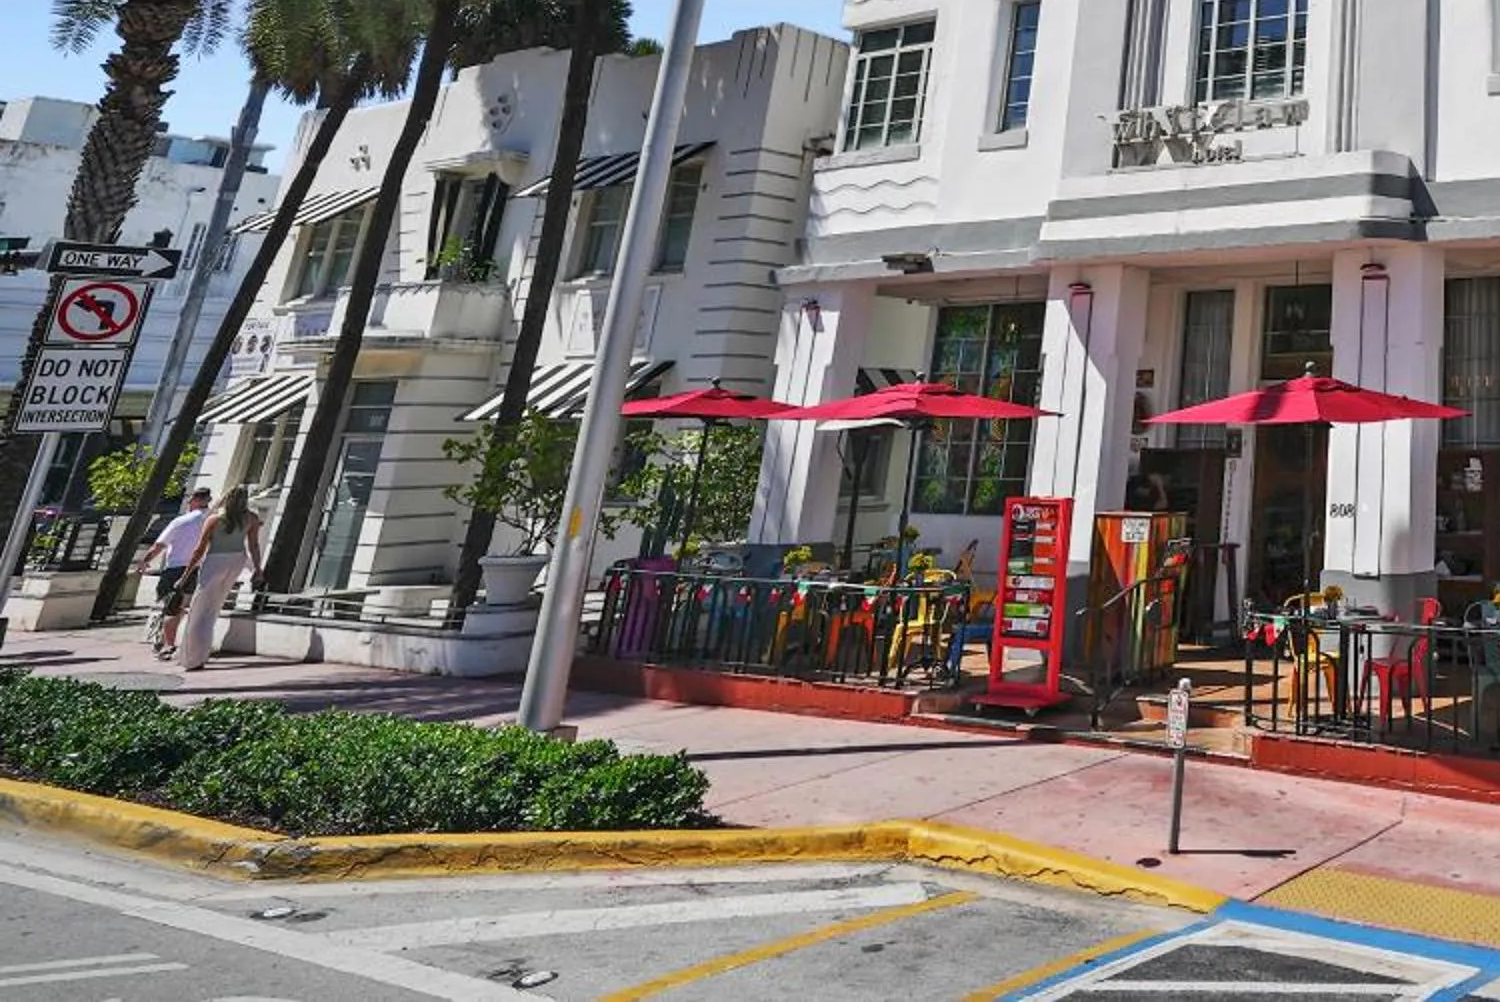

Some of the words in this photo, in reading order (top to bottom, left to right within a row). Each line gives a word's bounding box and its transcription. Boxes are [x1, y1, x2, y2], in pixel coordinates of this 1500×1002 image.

[63, 251, 100, 265] ONE
[107, 254, 143, 267] WAY
[39, 359, 71, 377] DO
[77, 359, 121, 377] NOT
[29, 385, 112, 405] BLOCK
[21, 409, 105, 423] INTERSECTION
[1330, 503, 1356, 518] 808
